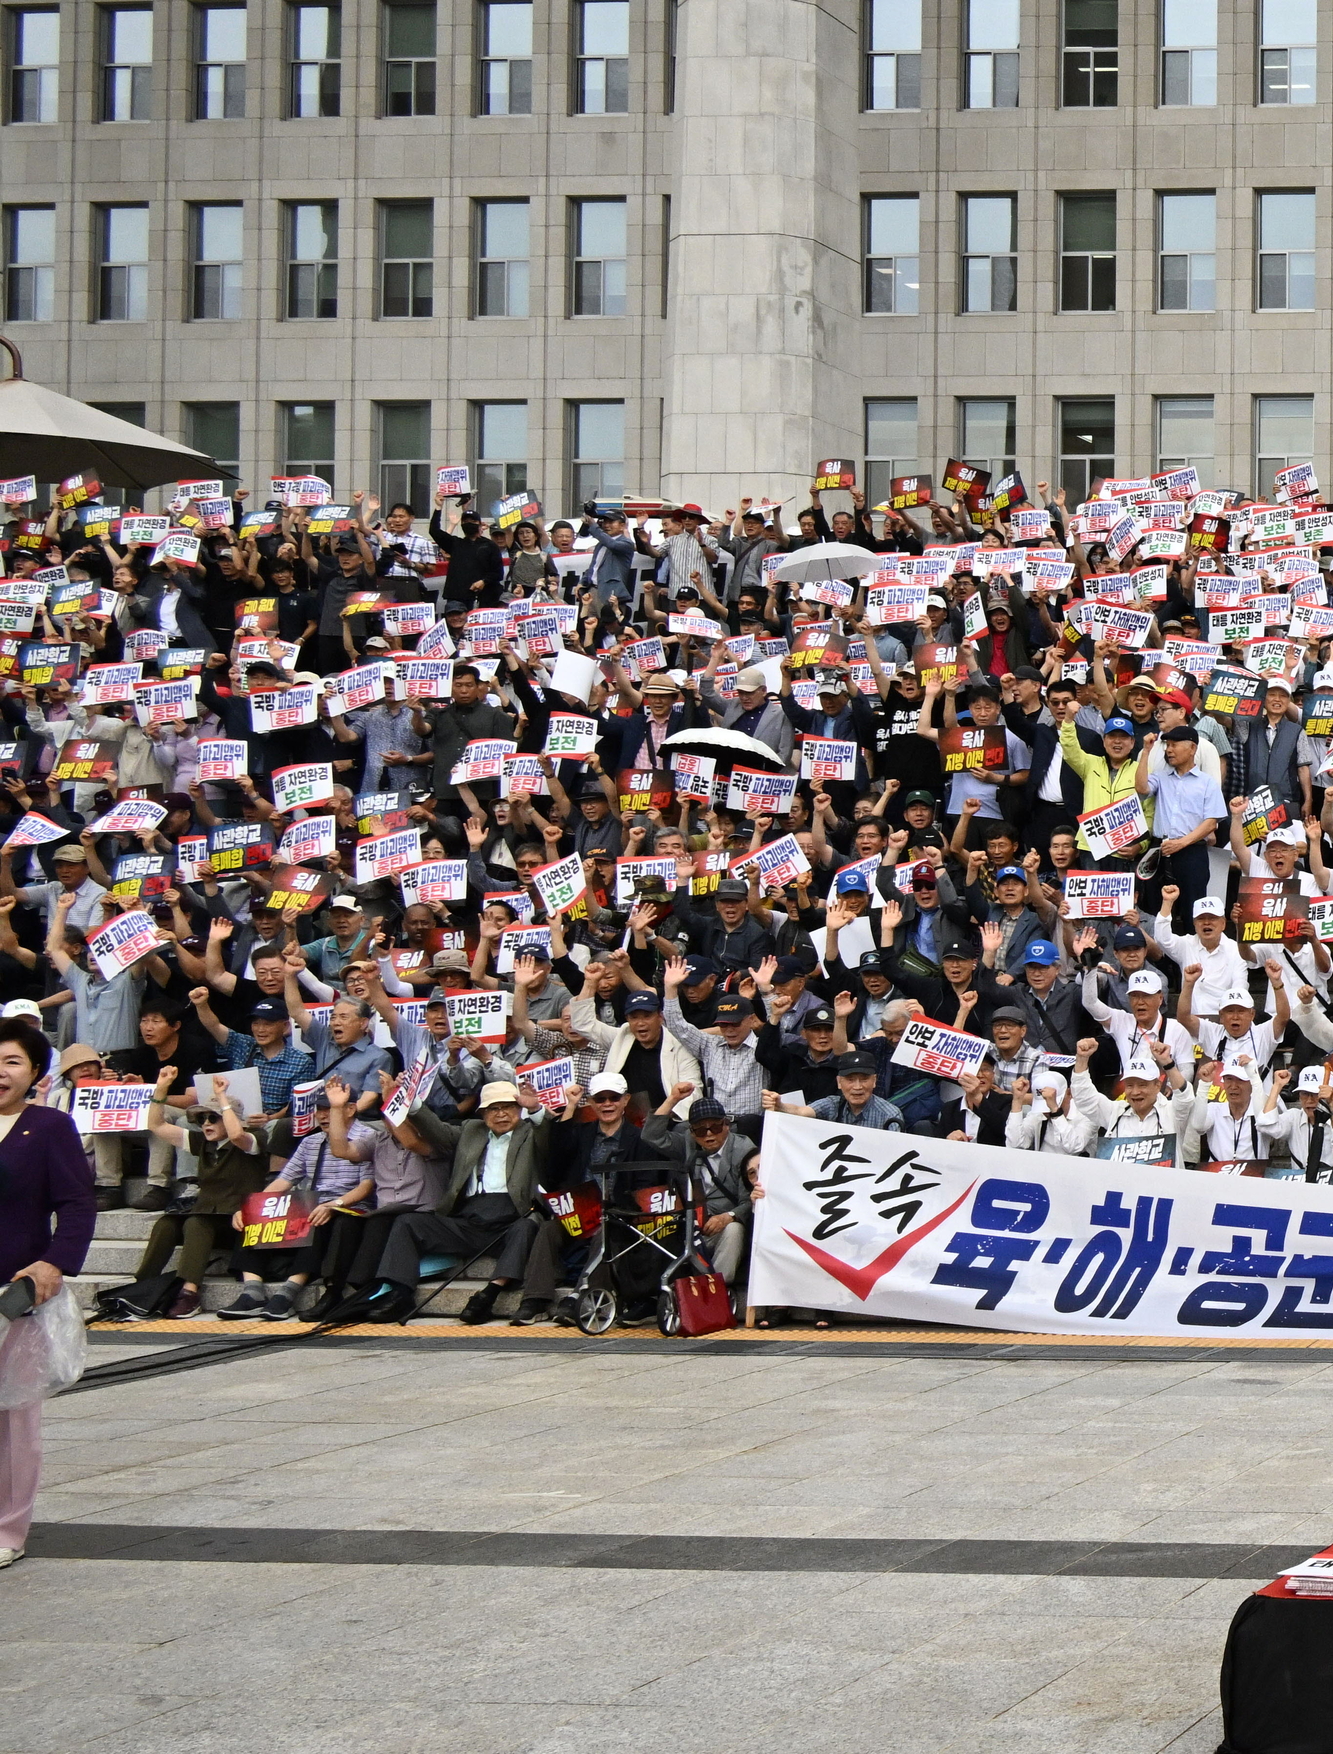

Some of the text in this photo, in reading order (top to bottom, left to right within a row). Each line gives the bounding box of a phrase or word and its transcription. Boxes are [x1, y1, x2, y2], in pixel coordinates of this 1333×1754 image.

[1095, 606, 1151, 632] 안보 자해행위
[1212, 612, 1262, 627] 태릉 자연환경
[1104, 628, 1130, 645] 중단
[1224, 626, 1250, 639] 보전
[396, 662, 451, 681] 국방 파괴행위
[407, 682, 434, 695] 중단
[1213, 678, 1260, 698] 사관학교
[254, 689, 314, 712] 국방 파괴행위
[1205, 694, 1262, 715] 통폐합 반대
[276, 711, 300, 724] 중단
[555, 719, 594, 736] 자연환경
[549, 735, 578, 751] 보전
[288, 766, 328, 785] 자연환경
[732, 772, 794, 796] 국방 파괴행위
[284, 784, 314, 805] 보전
[746, 796, 775, 810] 중단
[1084, 799, 1141, 838] 국방 파괴행위
[213, 824, 261, 849] 사관학교
[1110, 825, 1135, 845] 중단
[211, 847, 244, 871] 통폐합
[1134, 976, 1148, 984] NA
[14, 1003, 31, 1011] KMA
[904, 1024, 985, 1064] 안보 자해행위
[919, 1051, 959, 1075] 중단
[1304, 1074, 1319, 1082] NA
[79, 1088, 101, 1110] 국방
[99, 1112, 134, 1128] 중단
[802, 1134, 942, 1241] 졸속
[262, 1194, 291, 1219] 육사
[243, 1219, 287, 1247] 지방 이전
